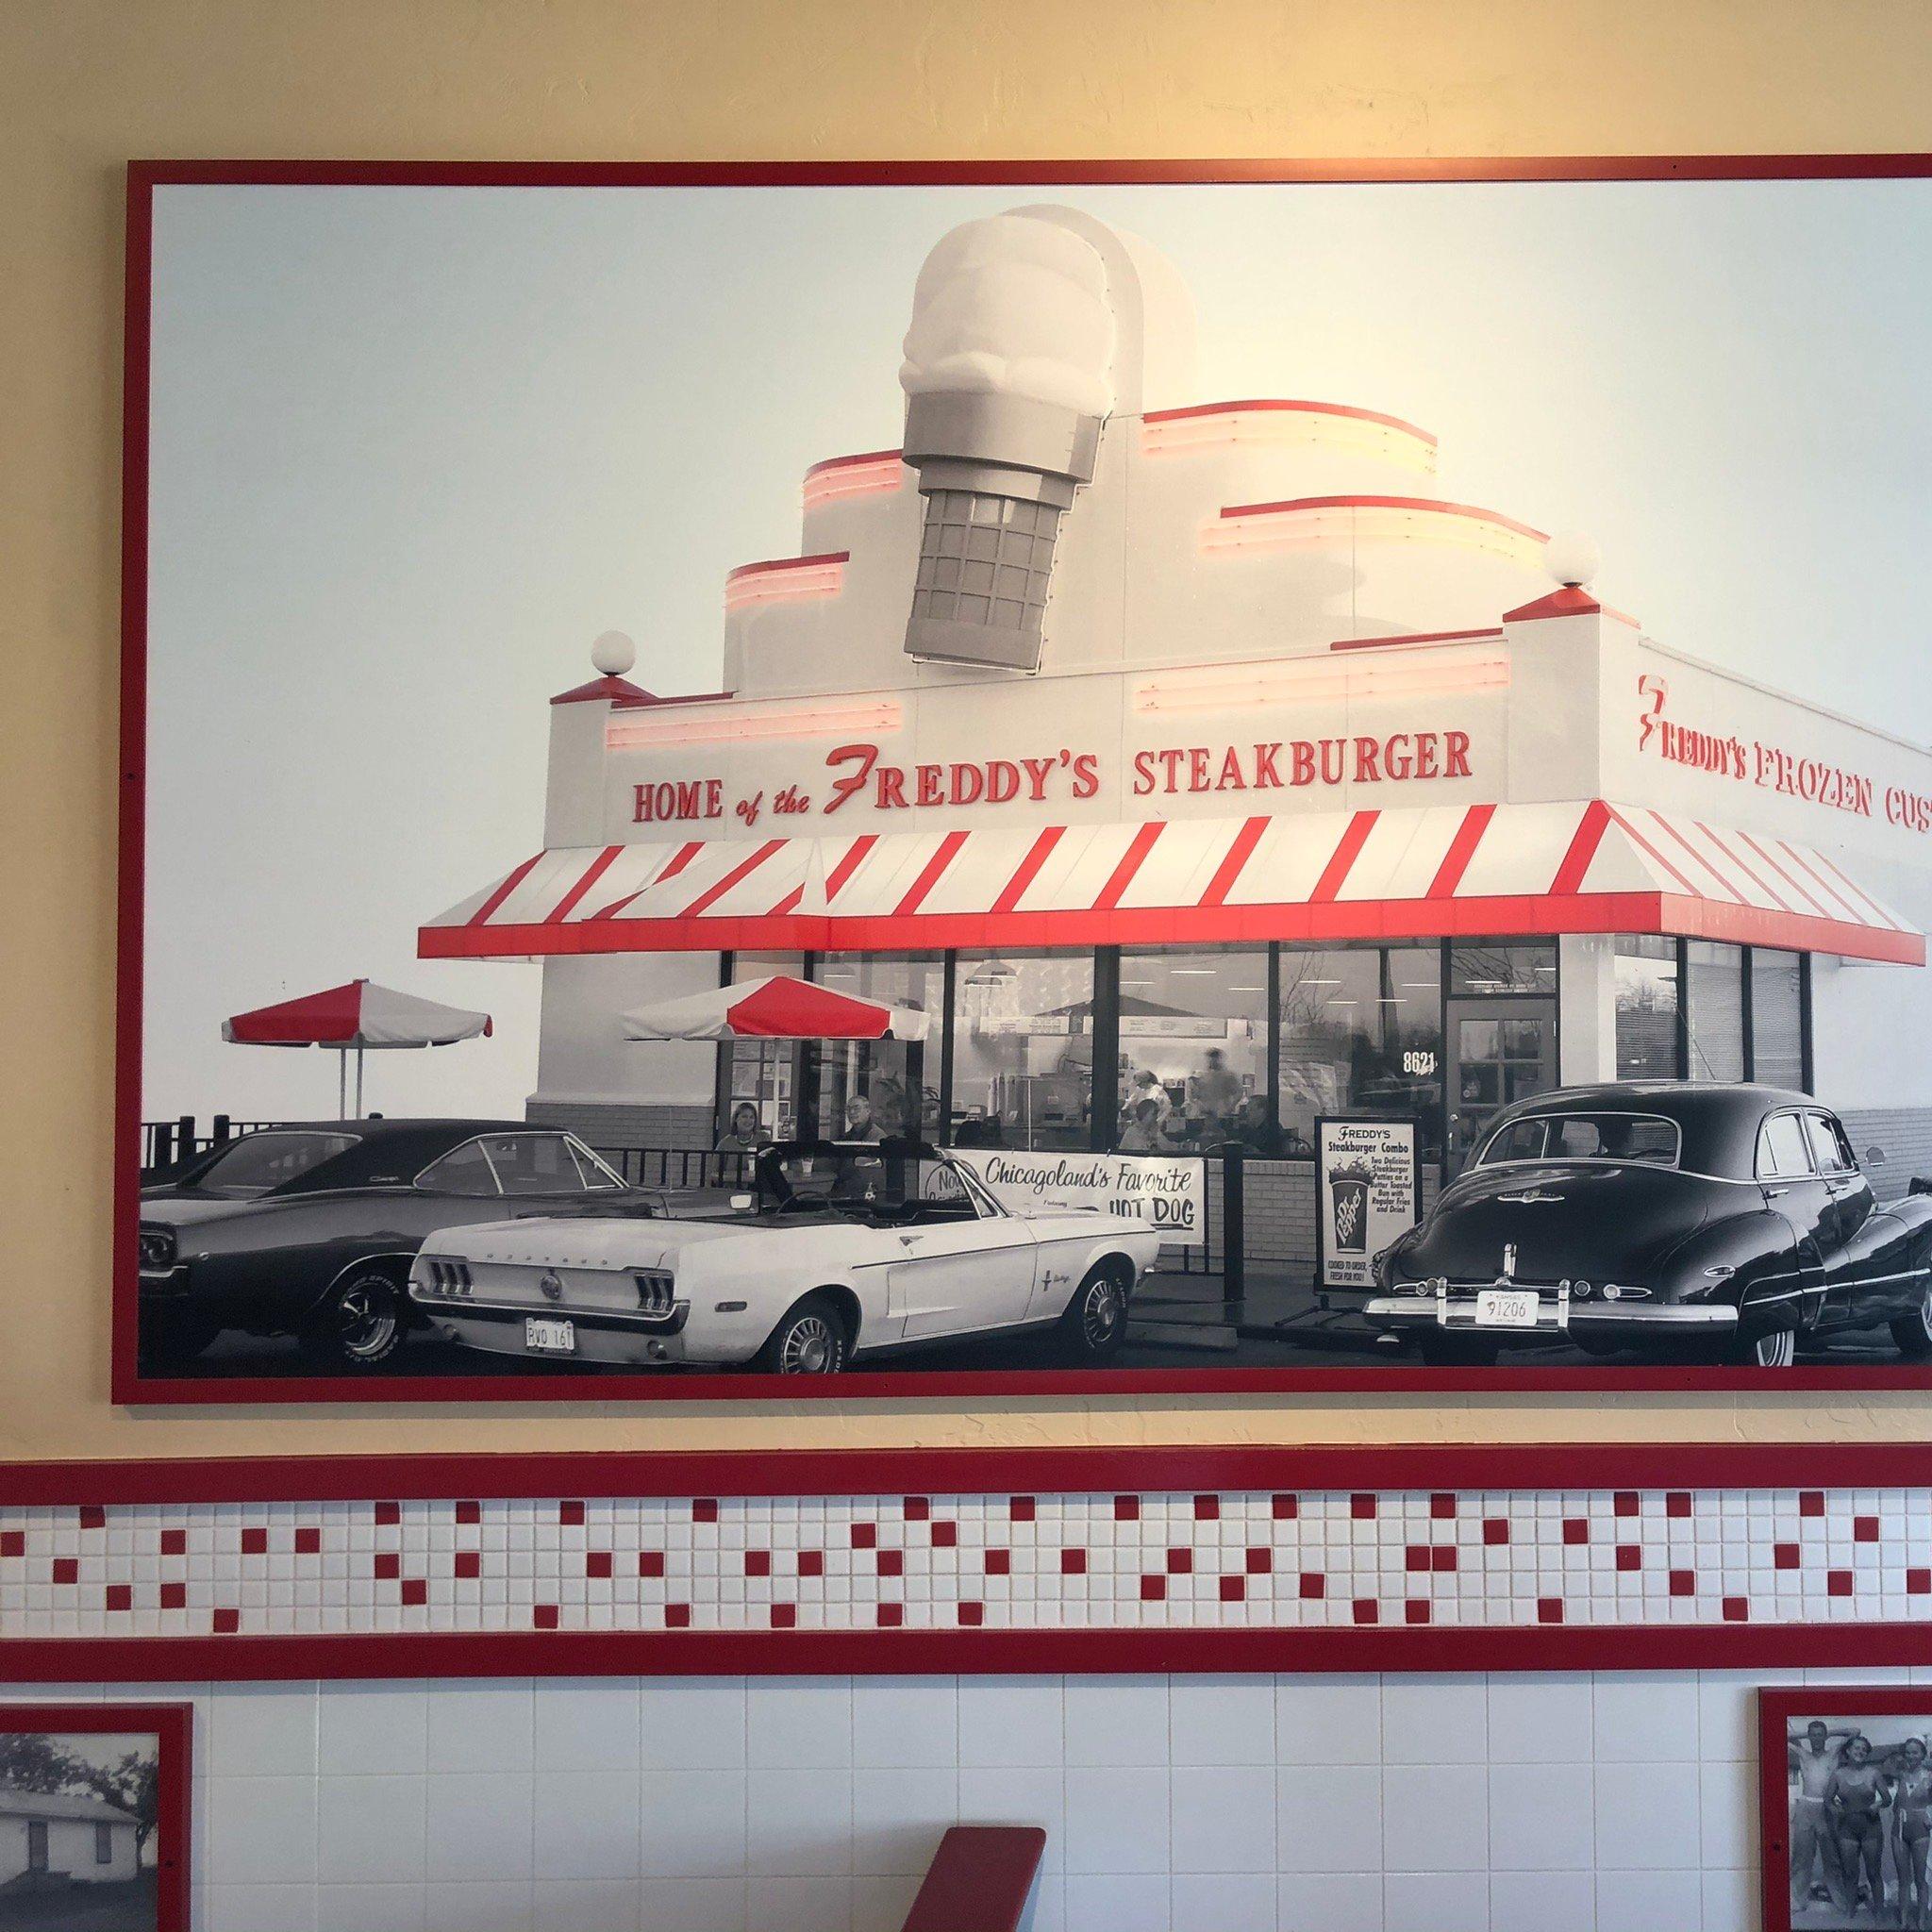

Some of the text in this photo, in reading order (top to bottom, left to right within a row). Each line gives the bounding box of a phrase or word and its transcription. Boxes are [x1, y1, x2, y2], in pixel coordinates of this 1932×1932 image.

[632, 730, 1474, 826] HOME of the FREDDY'S STEAKBURGER
[1754, 741, 1873, 817] FROZEN
[1885, 787, 1932, 833] CUS
[1403, 1051, 1435, 1074] 8621
[1338, 1125, 1391, 1141] FREDDY'S
[1328, 1141, 1409, 1155] Steakburger Combo
[1371, 1156, 1410, 1165] Two Delicious
[985, 1157, 1191, 1194] Chicagoland's Favorite
[1372, 1164, 1408, 1174] Steakburger
[1152, 1197, 1195, 1224] DOG
[1389, 1205, 1406, 1213] Drink
[1487, 1301, 1526, 1317] 91206
